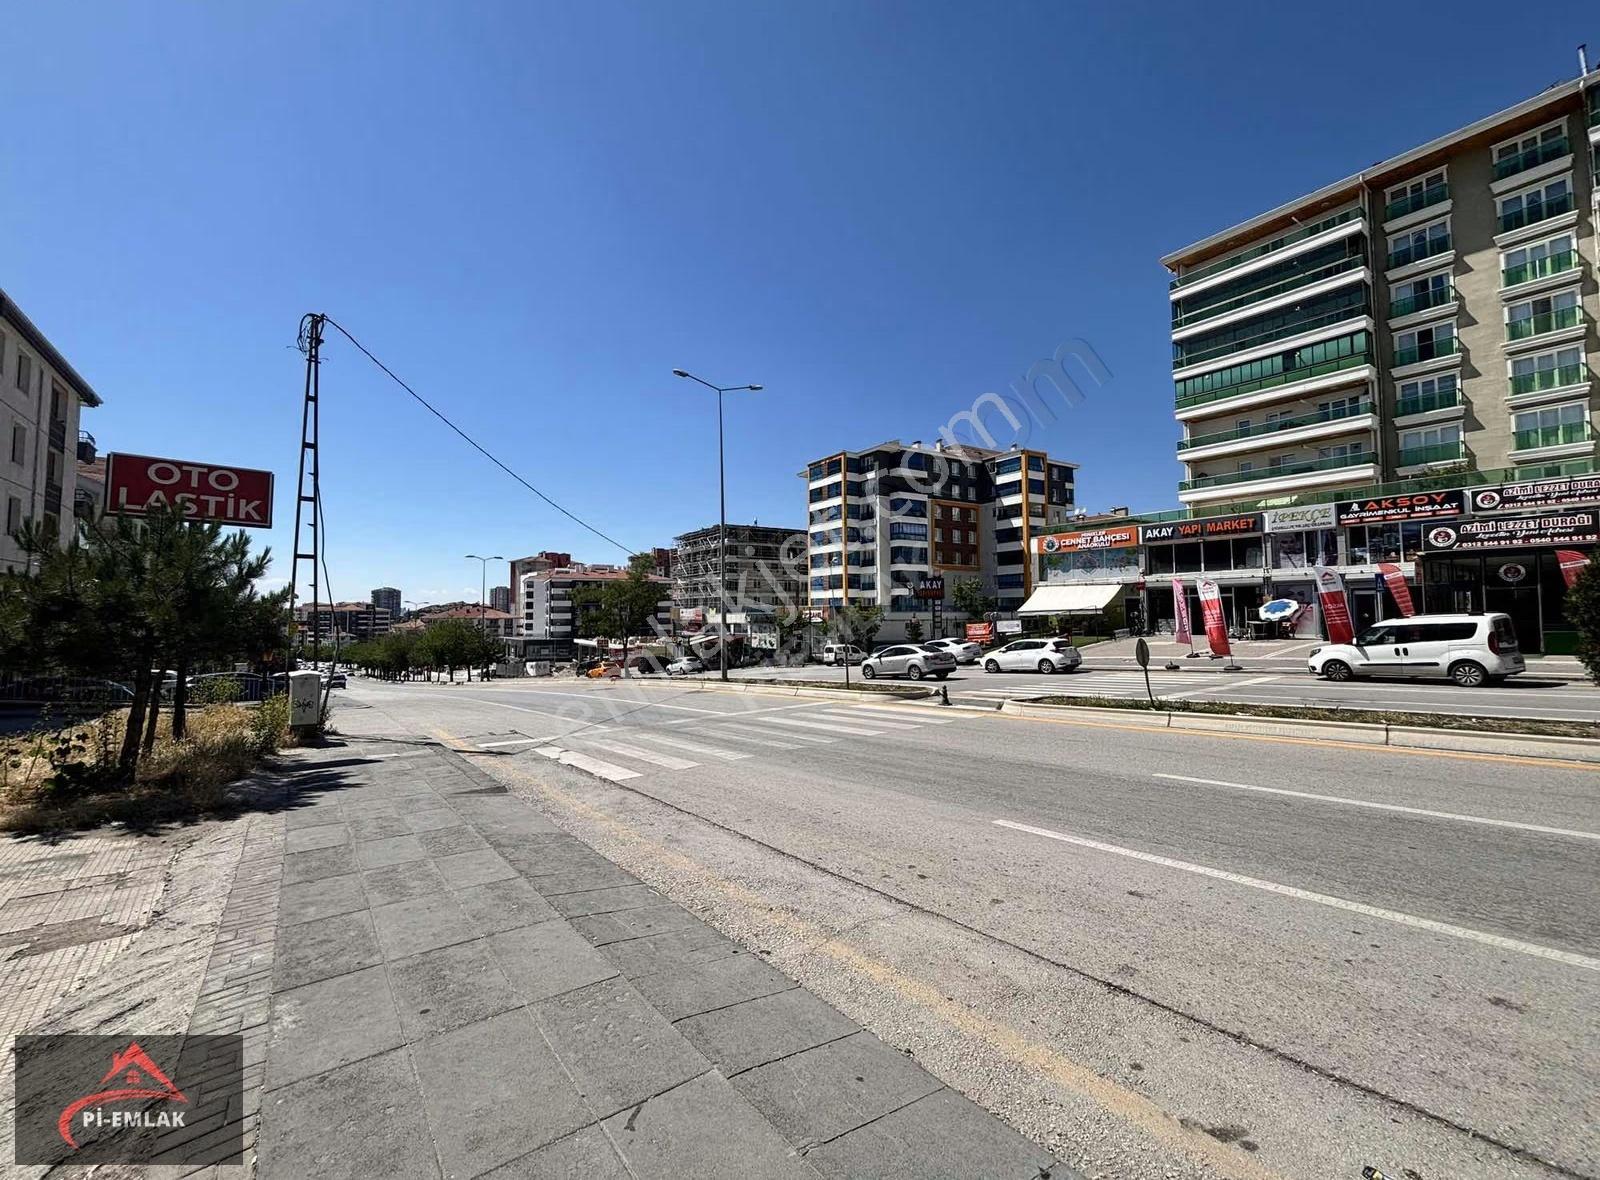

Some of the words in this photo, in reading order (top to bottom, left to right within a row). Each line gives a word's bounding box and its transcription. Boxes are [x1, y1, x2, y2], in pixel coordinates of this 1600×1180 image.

[147, 462, 240, 491] OTO
[1534, 482, 1570, 494] LEZZET
[118, 486, 263, 520] LASTİK
[1340, 507, 1411, 520] GAYRİMENKUL
[1414, 502, 1459, 512] İNŞAAT
[1364, 492, 1446, 511] AKSOY
[1146, 527, 1173, 539] AKAY
[1178, 523, 1201, 535] YAPI
[1206, 518, 1255, 533] MARKET
[1460, 520, 1496, 534] AZİMİ
[1497, 518, 1540, 532] LEZZET
[1541, 513, 1592, 529] DURAĞI
[1060, 537, 1092, 546] CENNET
[920, 580, 942, 589] AKAY
